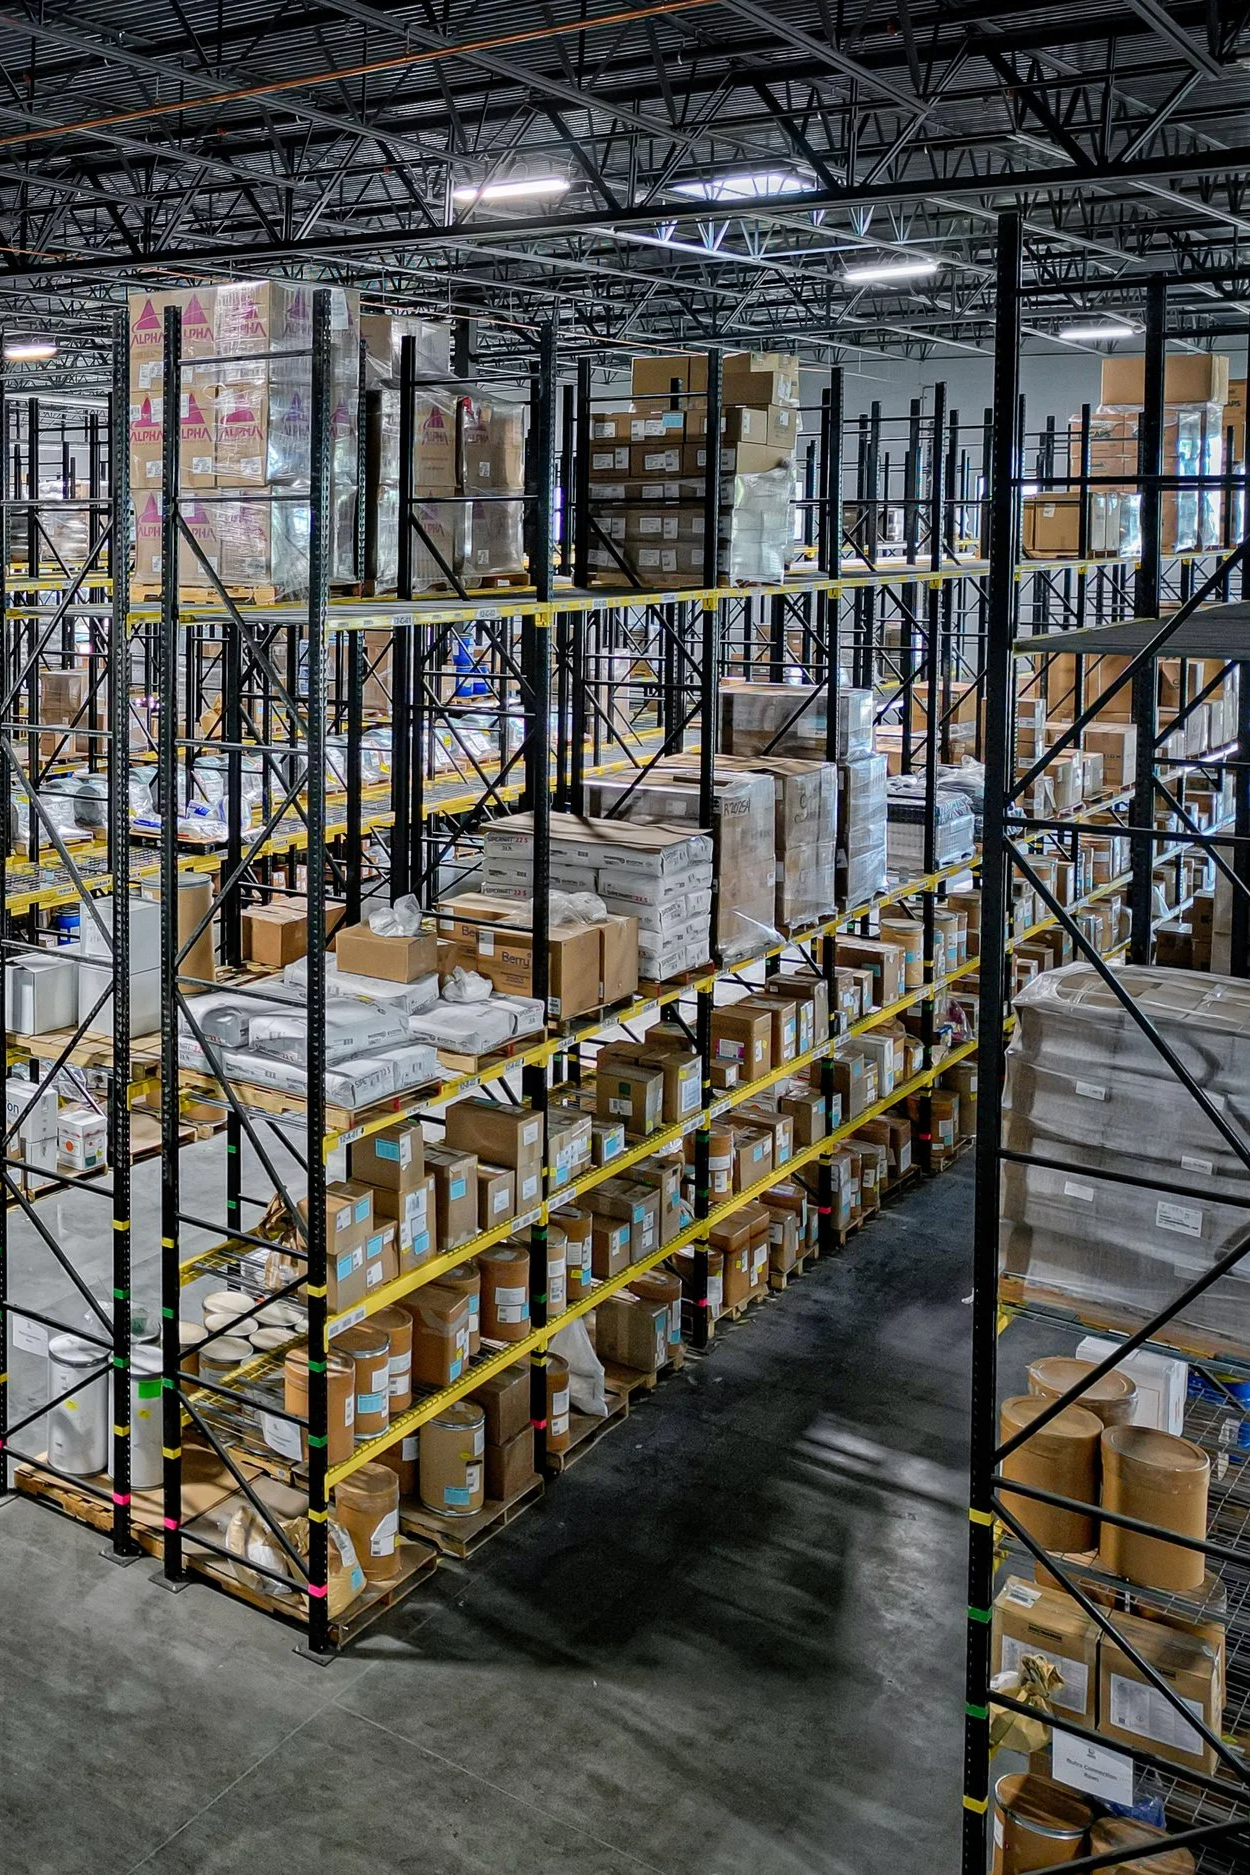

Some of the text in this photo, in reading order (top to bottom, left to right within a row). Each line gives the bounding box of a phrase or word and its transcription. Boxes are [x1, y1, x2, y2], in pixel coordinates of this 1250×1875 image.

[130, 332, 164, 349] ALPHA
[184, 326, 214, 342] LPHA
[130, 430, 163, 442] ALPHA
[182, 427, 212, 442] LPHA
[138, 526, 161, 537] ALPH
[191, 527, 217, 542] PHA
[501, 951, 530, 969] Berry
[7, 1102, 19, 1114] on
